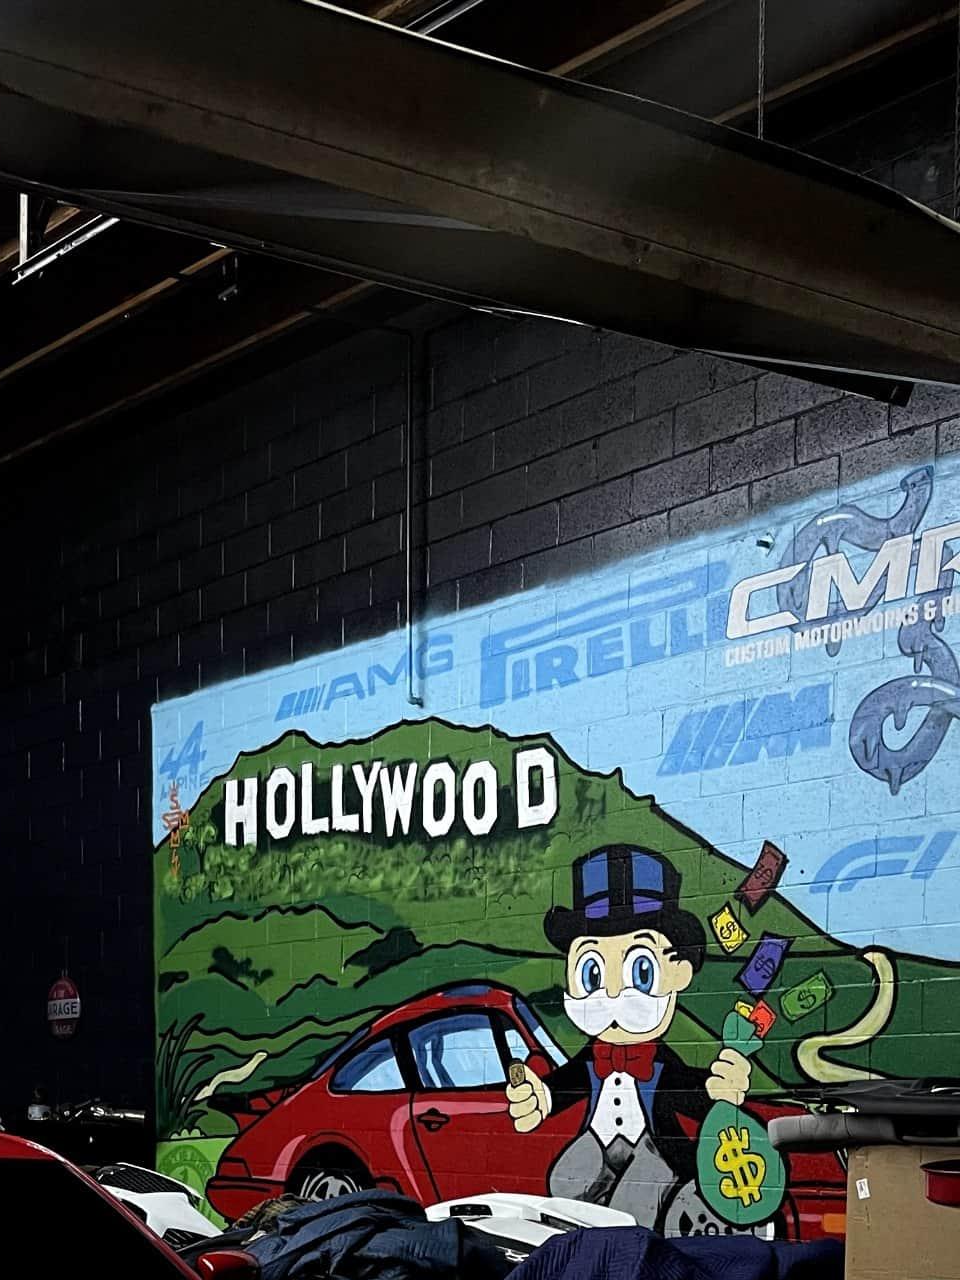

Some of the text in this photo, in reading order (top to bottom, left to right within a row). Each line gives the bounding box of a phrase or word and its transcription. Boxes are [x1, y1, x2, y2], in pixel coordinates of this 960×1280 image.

[323, 634, 454, 711] AMG
[480, 561, 731, 709] PIRELLI
[725, 635, 790, 668] CUSTOM
[794, 602, 918, 651] MOTORWORKS
[924, 599, 937, 621] &
[224, 746, 558, 847] HOLLYWOOD
